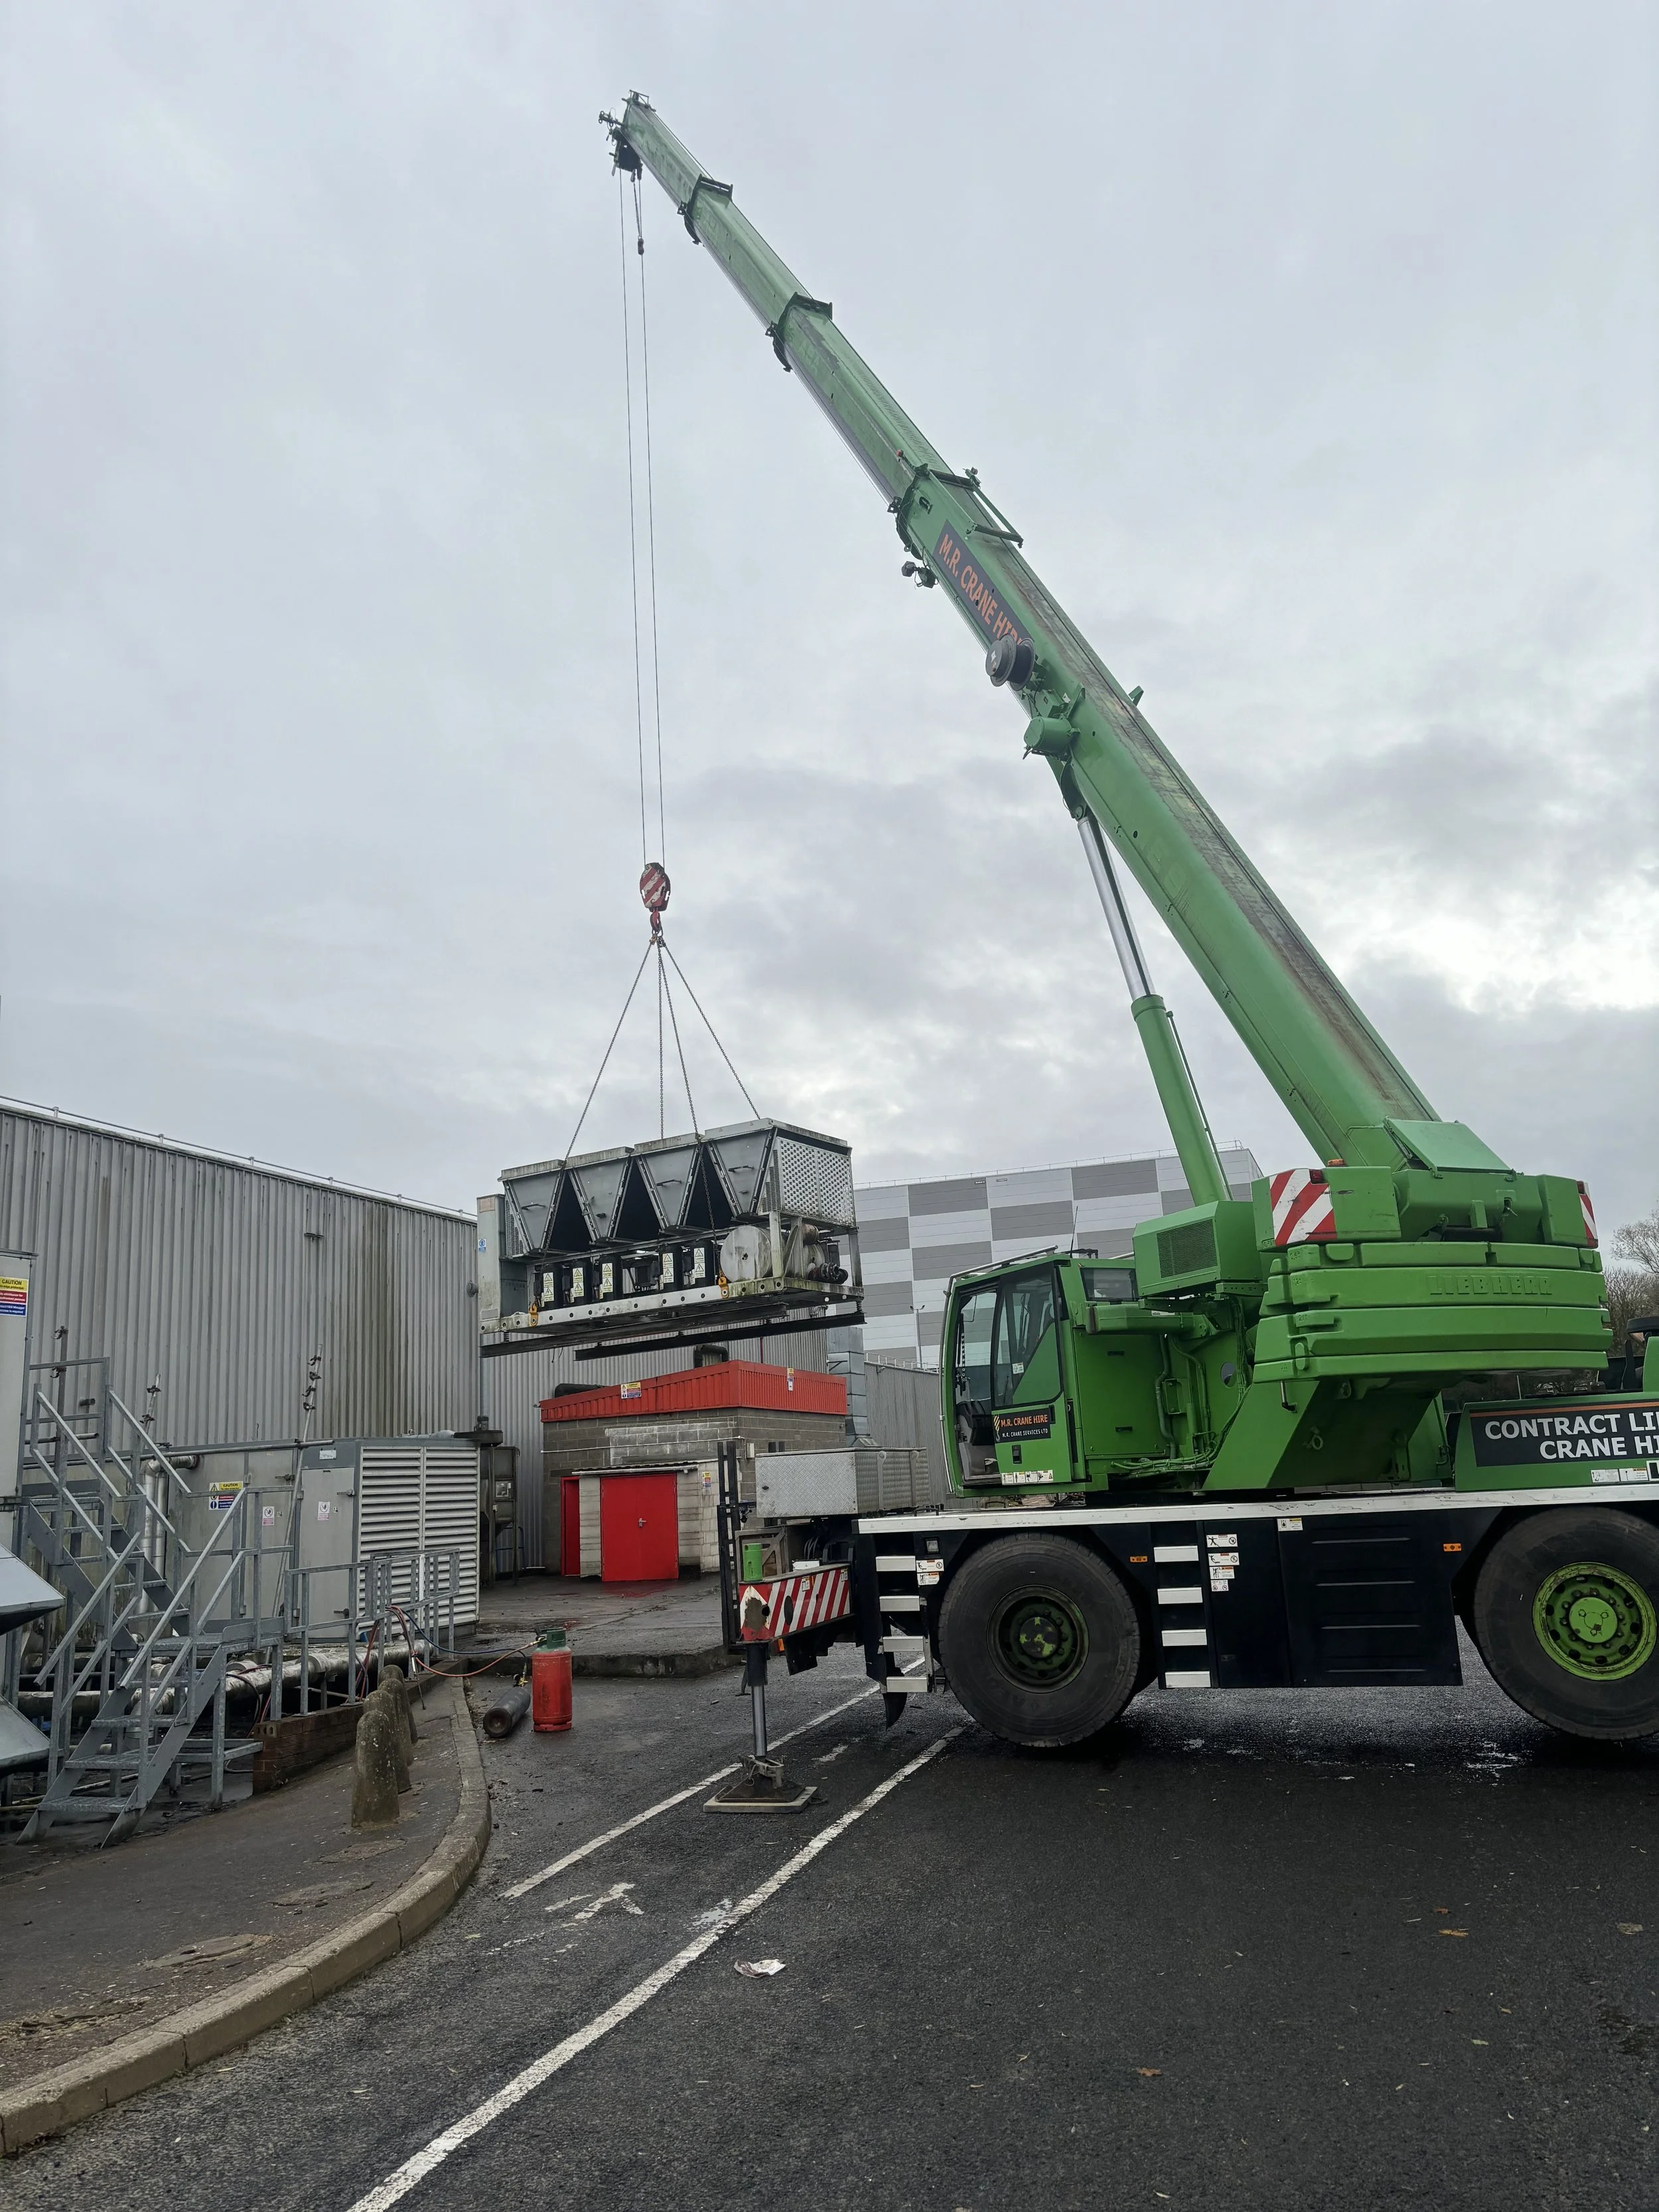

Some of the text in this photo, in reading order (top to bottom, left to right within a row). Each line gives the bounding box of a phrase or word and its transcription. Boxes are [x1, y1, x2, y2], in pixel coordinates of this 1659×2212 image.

[939, 534, 1023, 645] M.R. CRANE HIR
[1427, 1275, 1552, 1295] LIEBHERR
[1013, 1416, 1033, 1426] CRANE
[1033, 1414, 1048, 1424] HIRE
[1484, 1412, 1659, 1439] CONTRACT LI
[1540, 1437, 1627, 1459] CRANE
